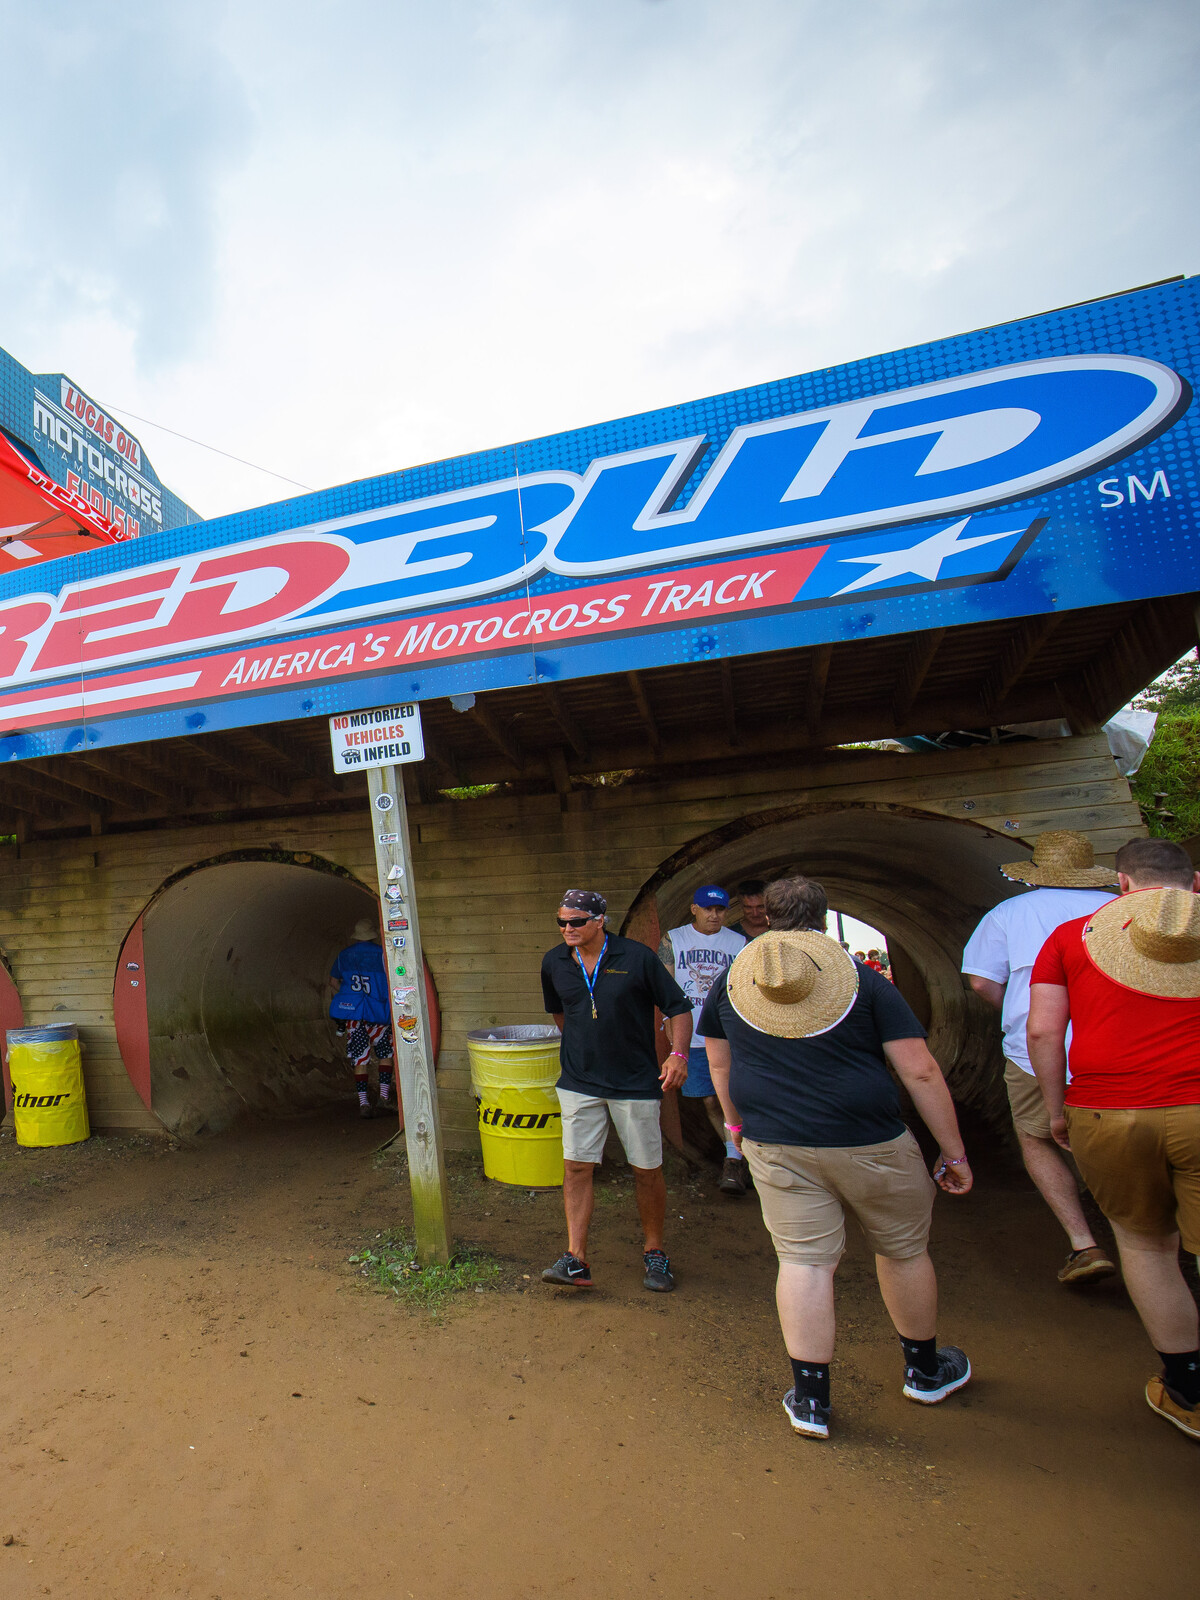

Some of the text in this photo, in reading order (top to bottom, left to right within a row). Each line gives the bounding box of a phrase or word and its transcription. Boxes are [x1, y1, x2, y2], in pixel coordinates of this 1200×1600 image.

[65, 386, 139, 465] LUCAS OIL
[33, 400, 163, 524] MOTOCROSS
[1097, 470, 1172, 508] SM
[66, 467, 140, 539] FINISH
[220, 569, 777, 688] AMERICA'S MOTOCROSS TRACK
[333, 704, 415, 731] NO MOTORIZED
[344, 724, 405, 747] VEHICLES
[364, 741, 411, 762] INFIELD
[351, 974, 370, 995] 35
[16, 1093, 70, 1108] thor
[483, 1108, 561, 1129] thor
